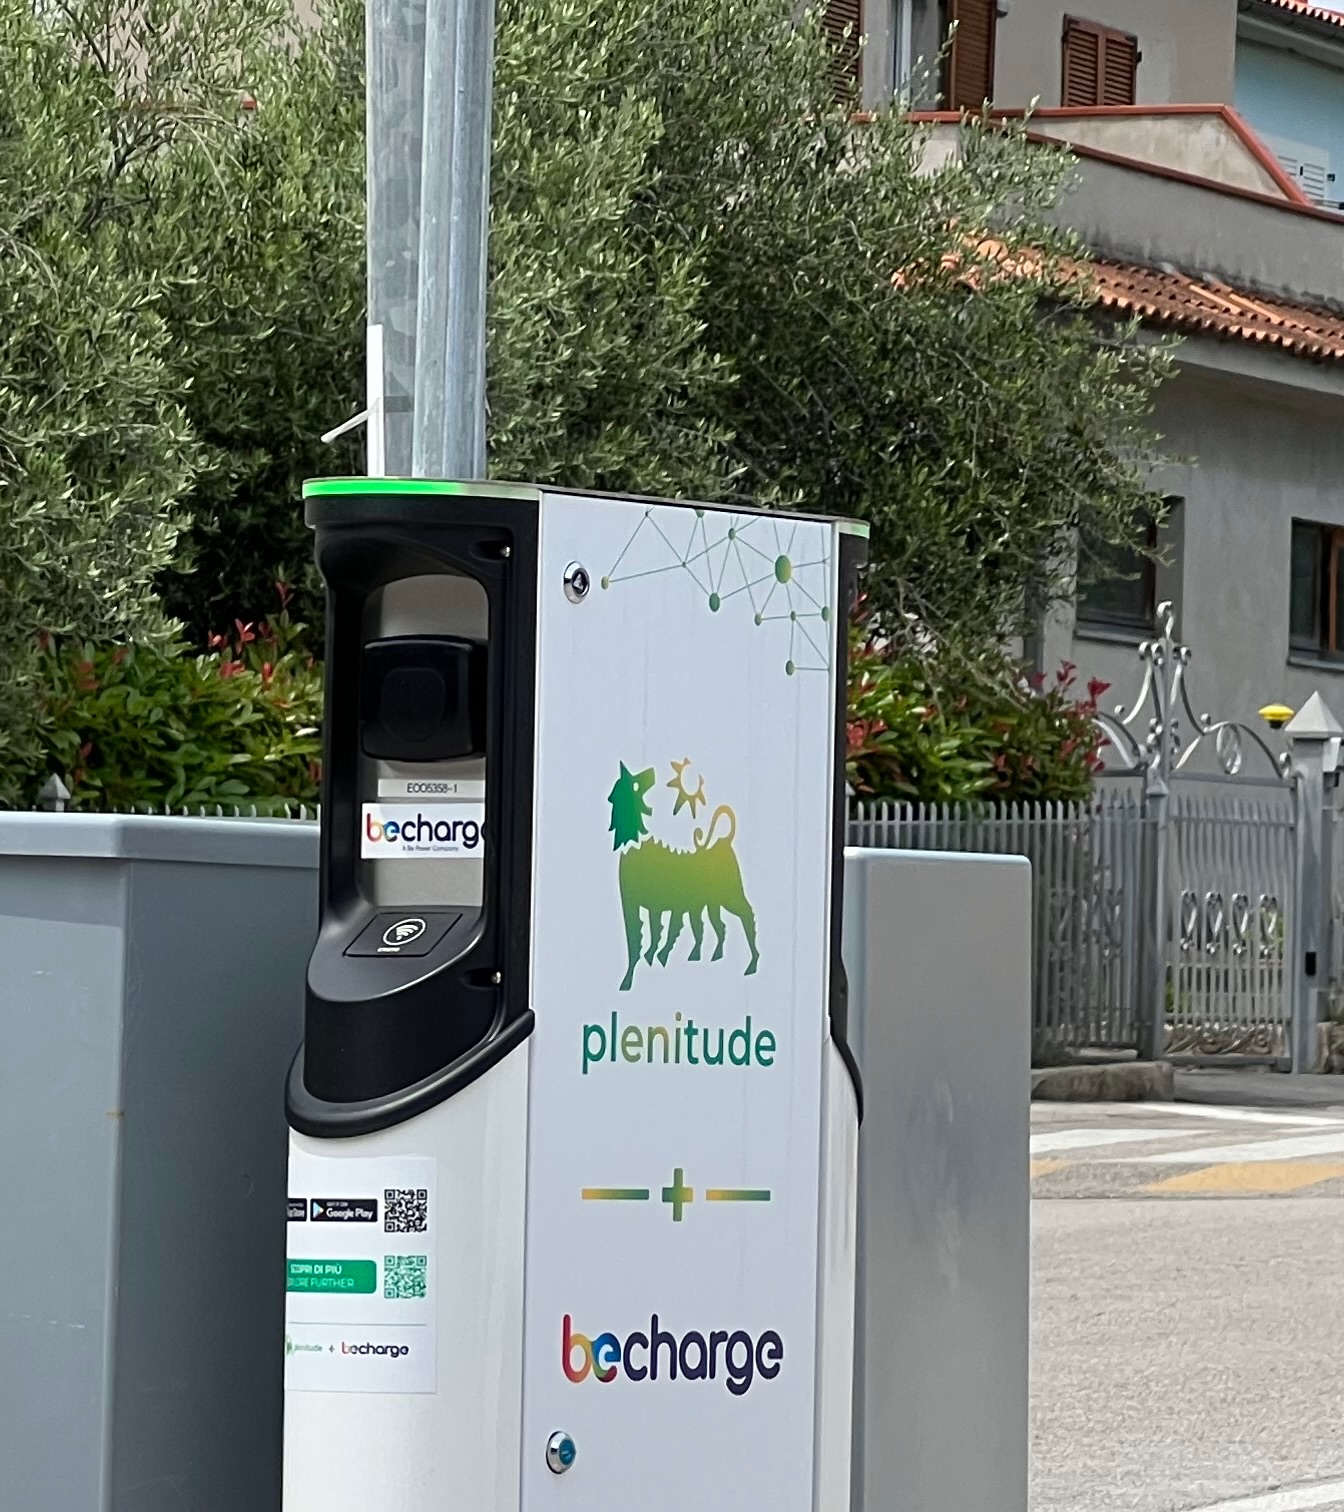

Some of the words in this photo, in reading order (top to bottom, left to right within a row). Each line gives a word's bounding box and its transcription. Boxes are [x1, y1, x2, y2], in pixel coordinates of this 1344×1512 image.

[582, 1010, 777, 1075] plenitude
[326, 1207, 355, 1220] Google
[355, 1207, 374, 1220] Play
[313, 1264, 324, 1275] DI
[310, 1278, 355, 1289] FURTHER
[341, 1341, 410, 1358] becharge
[561, 1313, 784, 1396] becharge
